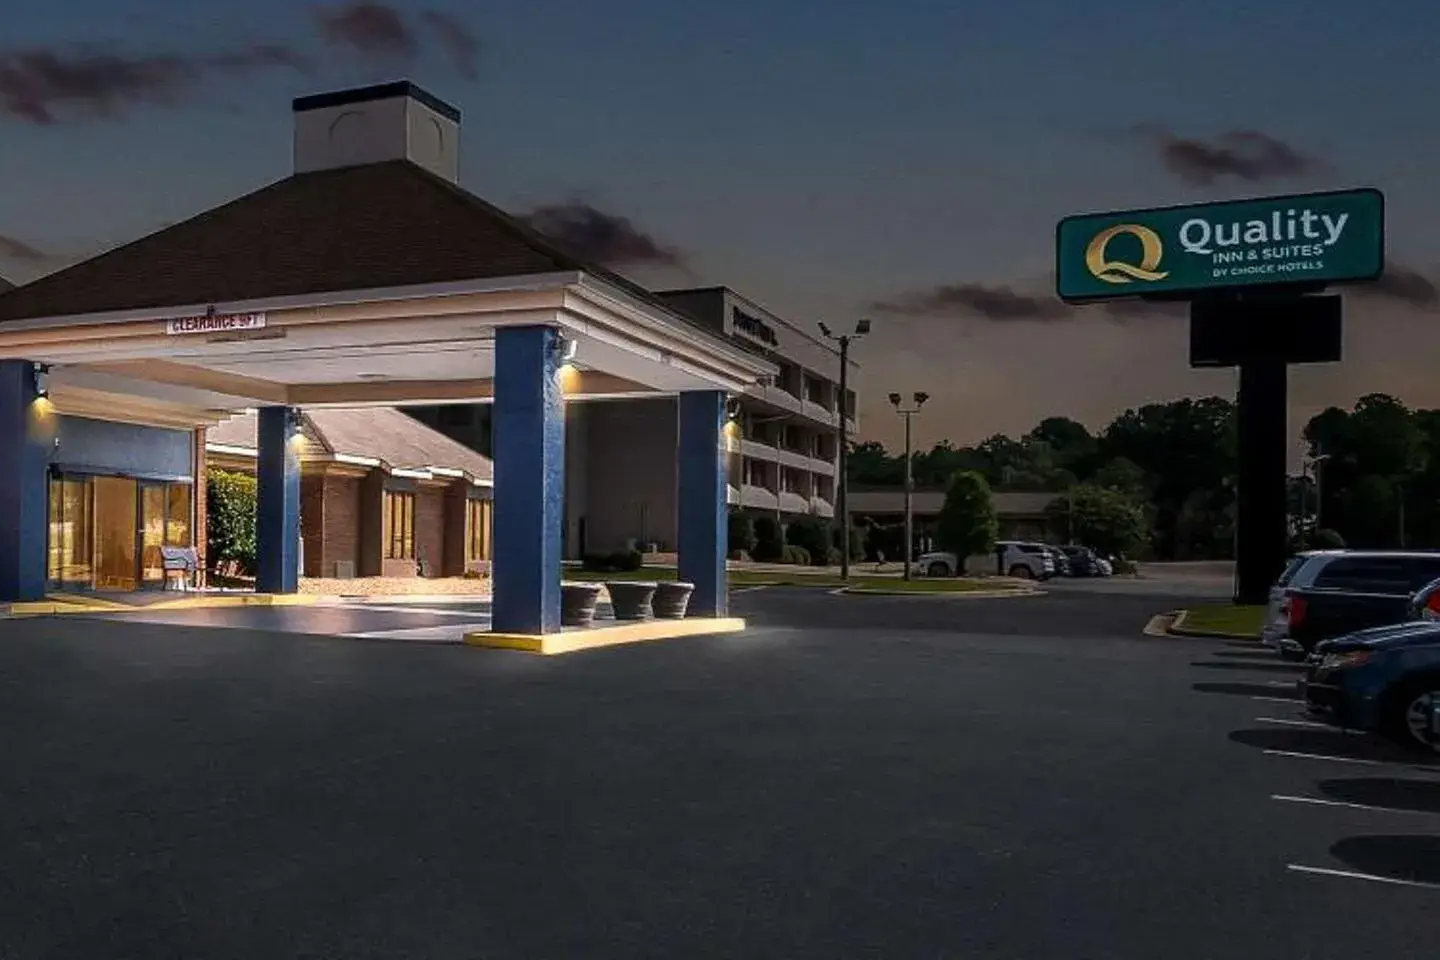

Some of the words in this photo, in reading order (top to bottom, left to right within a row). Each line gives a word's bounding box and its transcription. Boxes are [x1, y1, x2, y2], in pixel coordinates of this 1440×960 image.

[1178, 208, 1350, 255] Quality
[1212, 250, 1244, 265] INN
[1246, 249, 1259, 261] &
[1262, 243, 1325, 260] SUITES
[1212, 267, 1228, 278] BY
[1230, 263, 1275, 277] CHOICE
[1277, 259, 1325, 273] HOTELS
[173, 315, 236, 331] CLEARANCE
